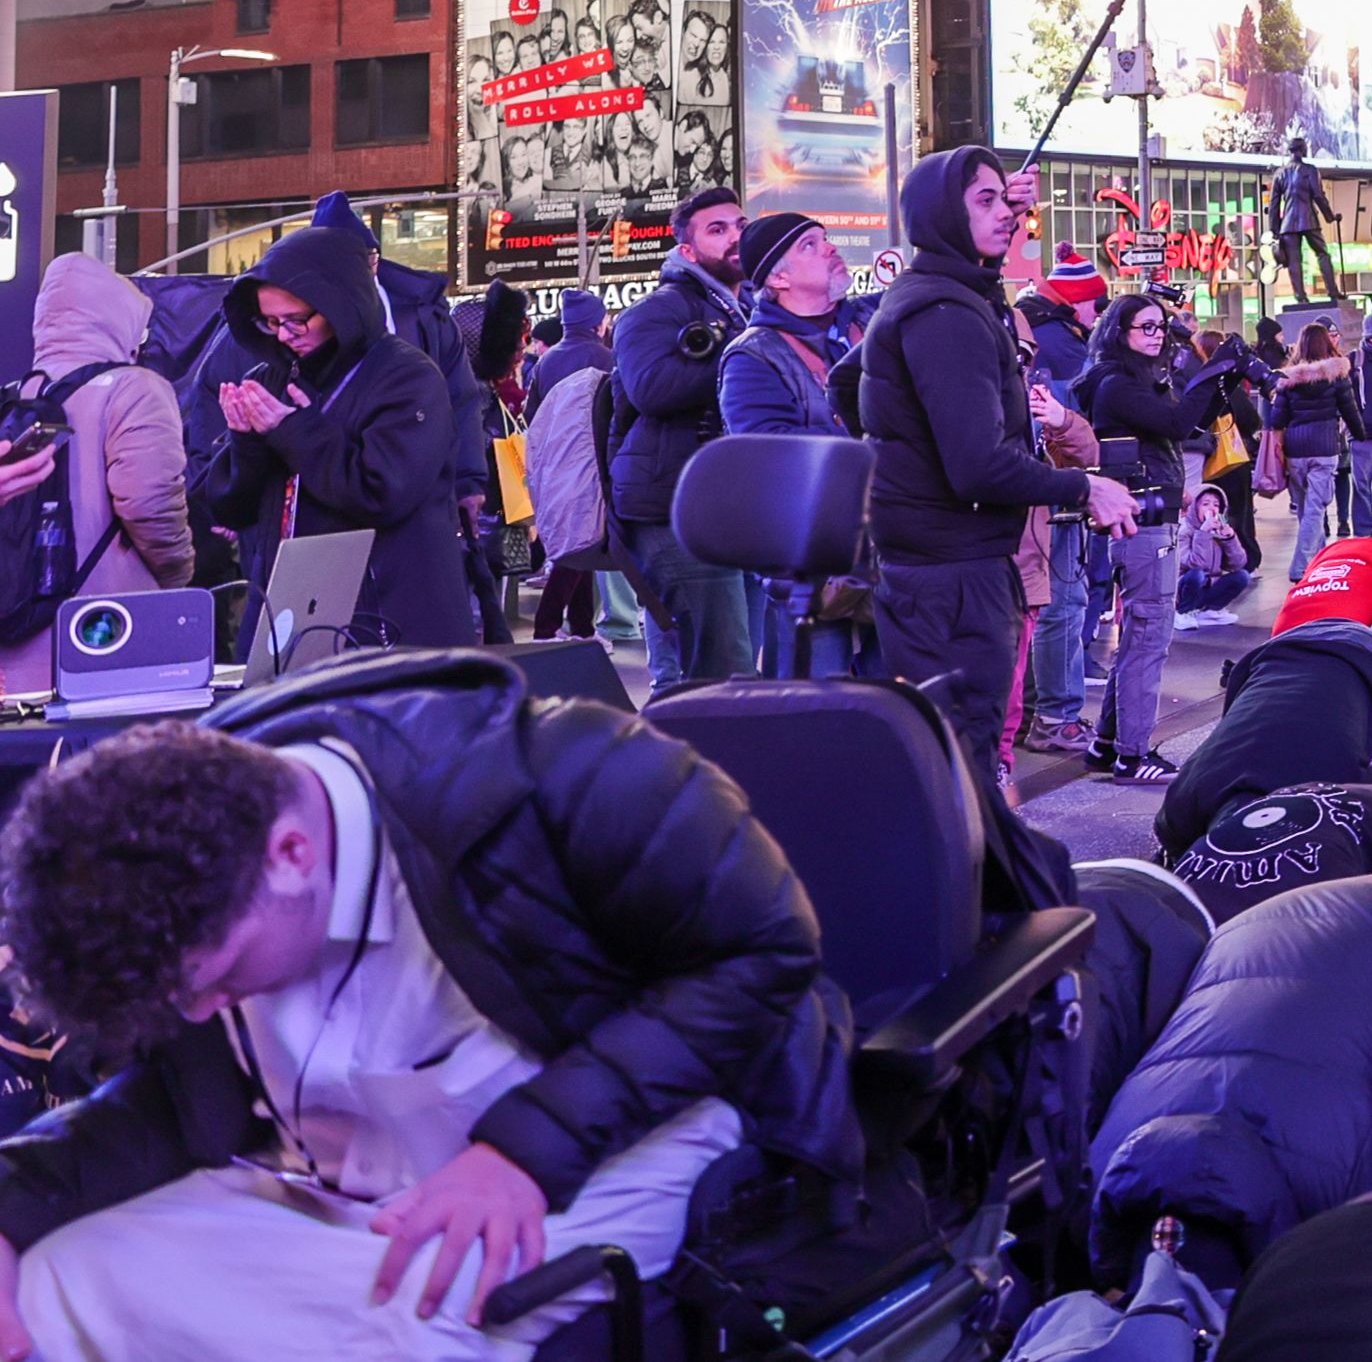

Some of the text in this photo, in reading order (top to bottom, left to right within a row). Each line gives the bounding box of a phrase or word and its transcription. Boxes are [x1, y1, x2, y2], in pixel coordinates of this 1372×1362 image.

[482, 53, 606, 99] MERRILY WE
[509, 93, 636, 120] ROLL ALONG
[652, 193, 678, 204] MARIA
[537, 202, 573, 213] STEPHEN
[534, 211, 576, 221] SONDHEIM
